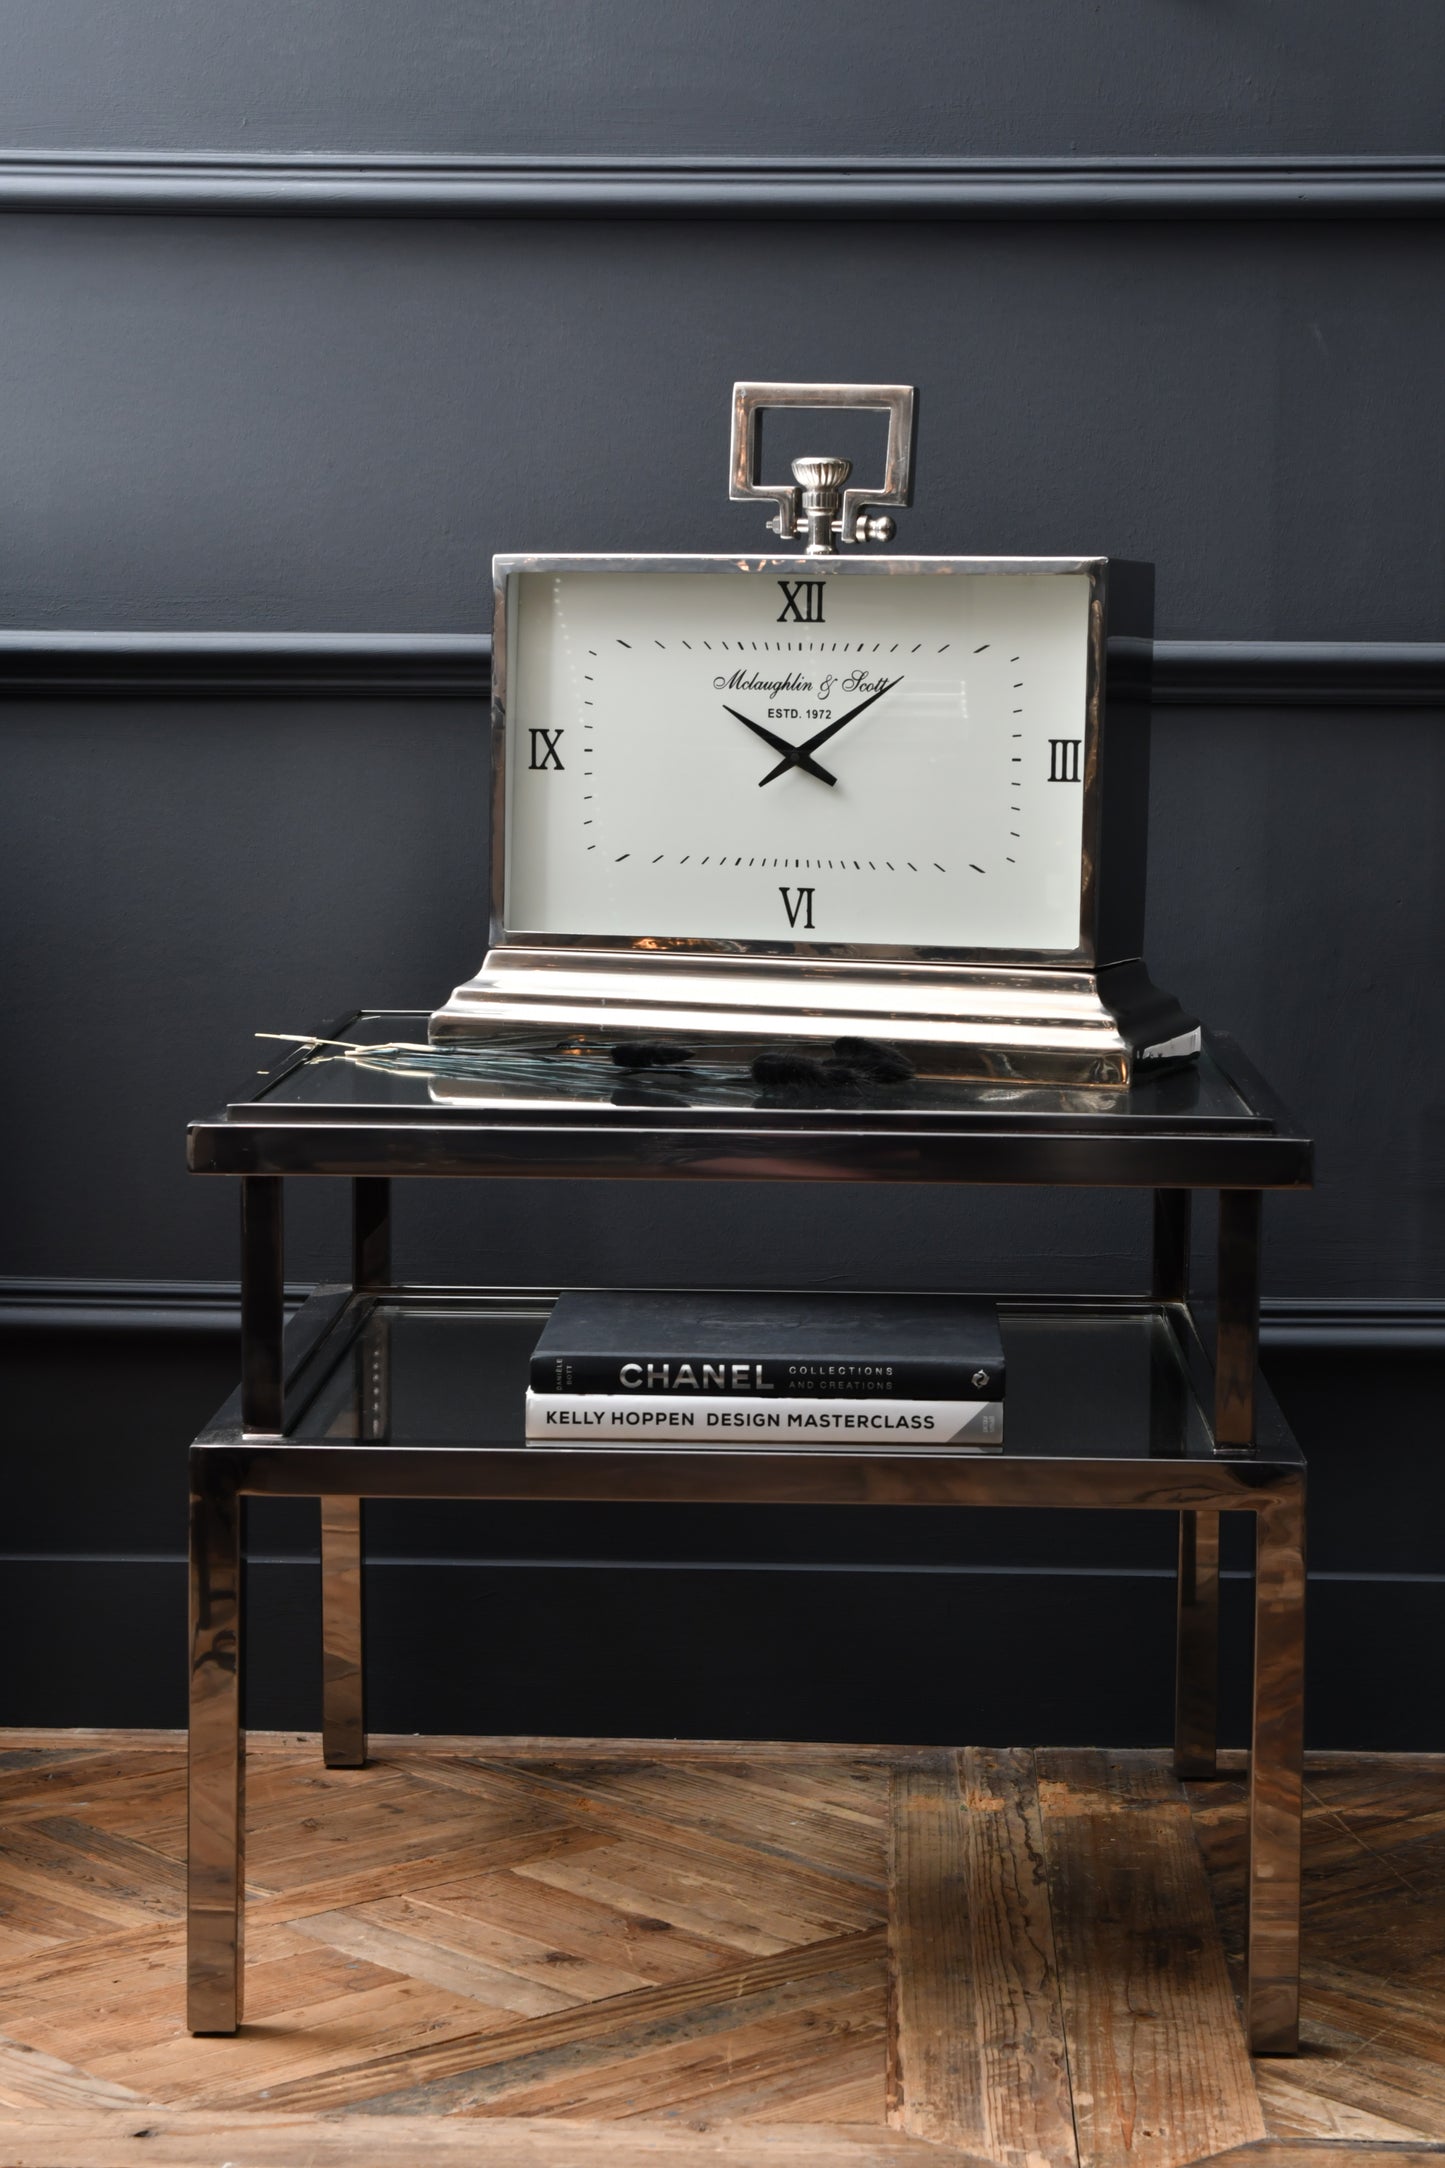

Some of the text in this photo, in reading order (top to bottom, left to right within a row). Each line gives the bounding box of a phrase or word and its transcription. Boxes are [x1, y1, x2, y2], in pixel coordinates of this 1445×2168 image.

[776, 581, 826, 623] XII
[713, 668, 890, 700] Mclaughlin & Scott
[767, 708, 832, 720] ESTD. 1972
[528, 728, 565, 771] IX
[1047, 739, 1082, 783] III
[779, 888, 816, 930] VI
[619, 1363, 775, 1390] CHANEL
[788, 1366, 894, 1376] COLLECTIONS
[788, 1380, 894, 1390] AND CREATIONS
[546, 1411, 936, 1429] KELLY HOPPEN DESIGN MASTERCLASS
